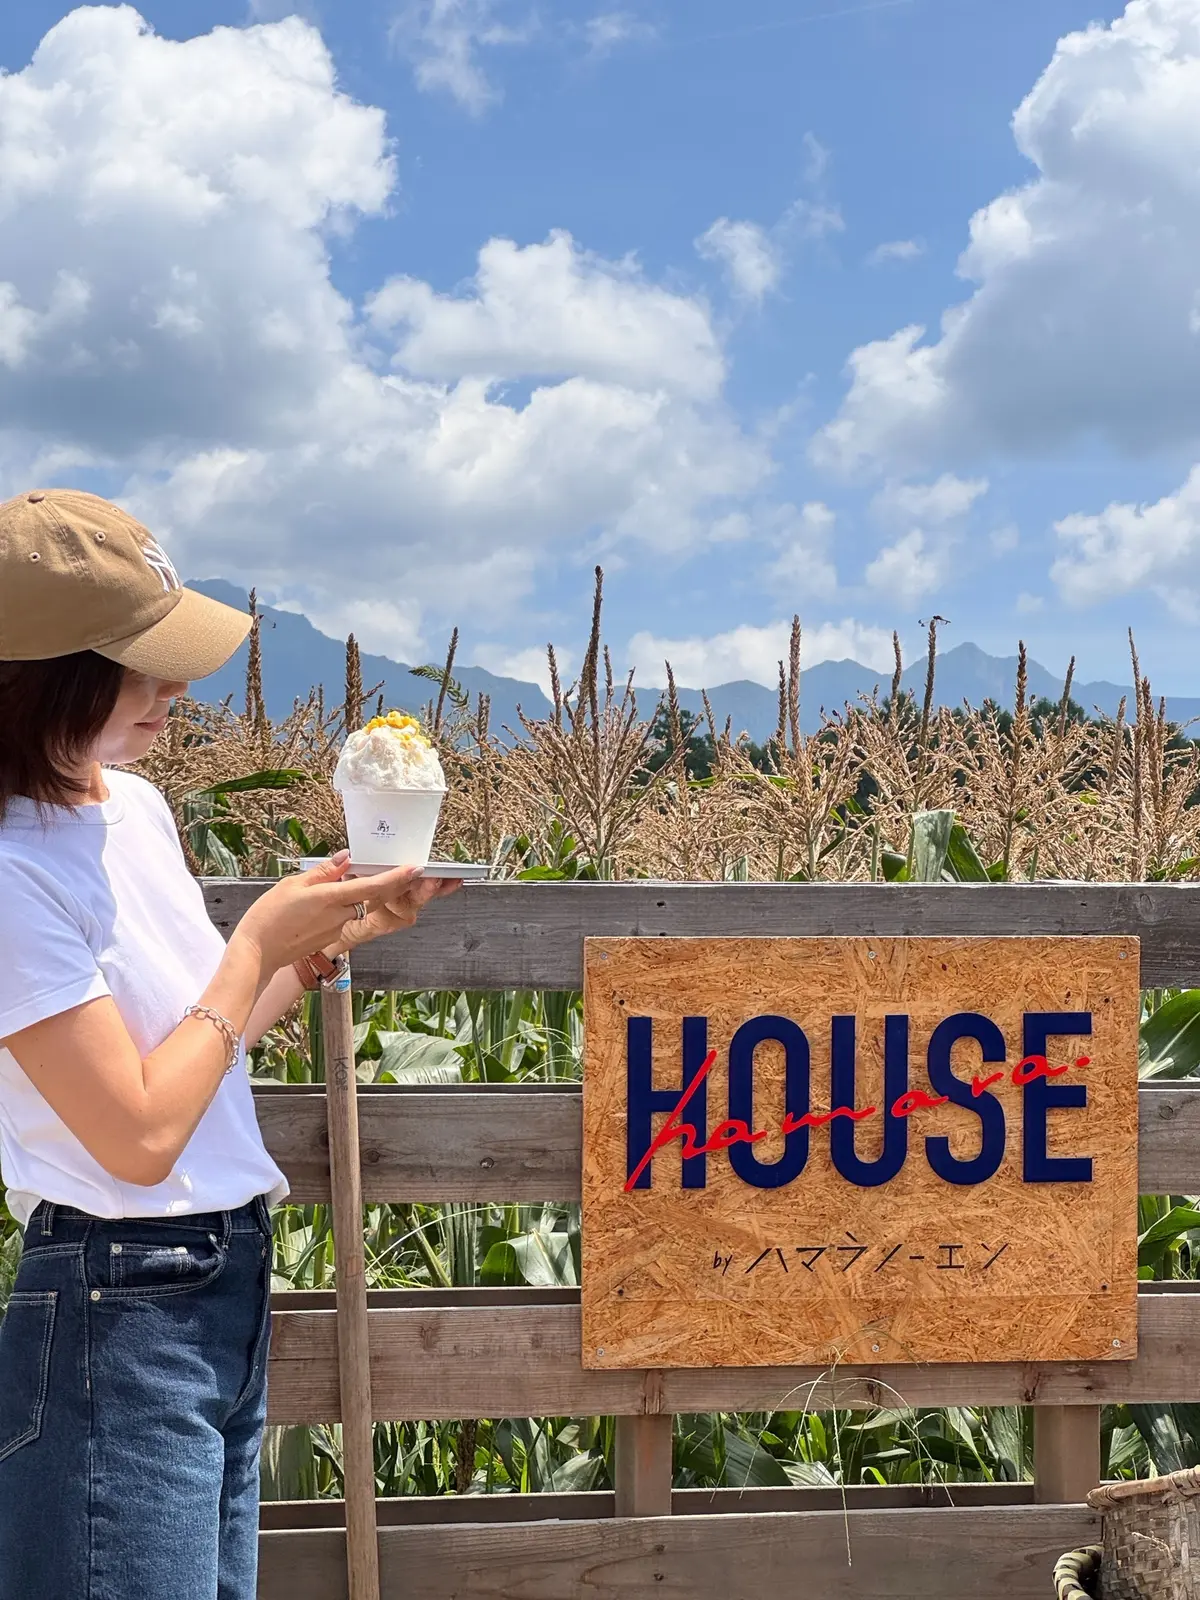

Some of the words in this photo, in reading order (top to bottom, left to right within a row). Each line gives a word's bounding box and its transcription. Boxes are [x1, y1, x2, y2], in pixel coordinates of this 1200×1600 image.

[626, 1012, 1093, 1189] HOUSE
[713, 1250, 733, 1276] by
[744, 1231, 1009, 1274] ハマラノーエン
